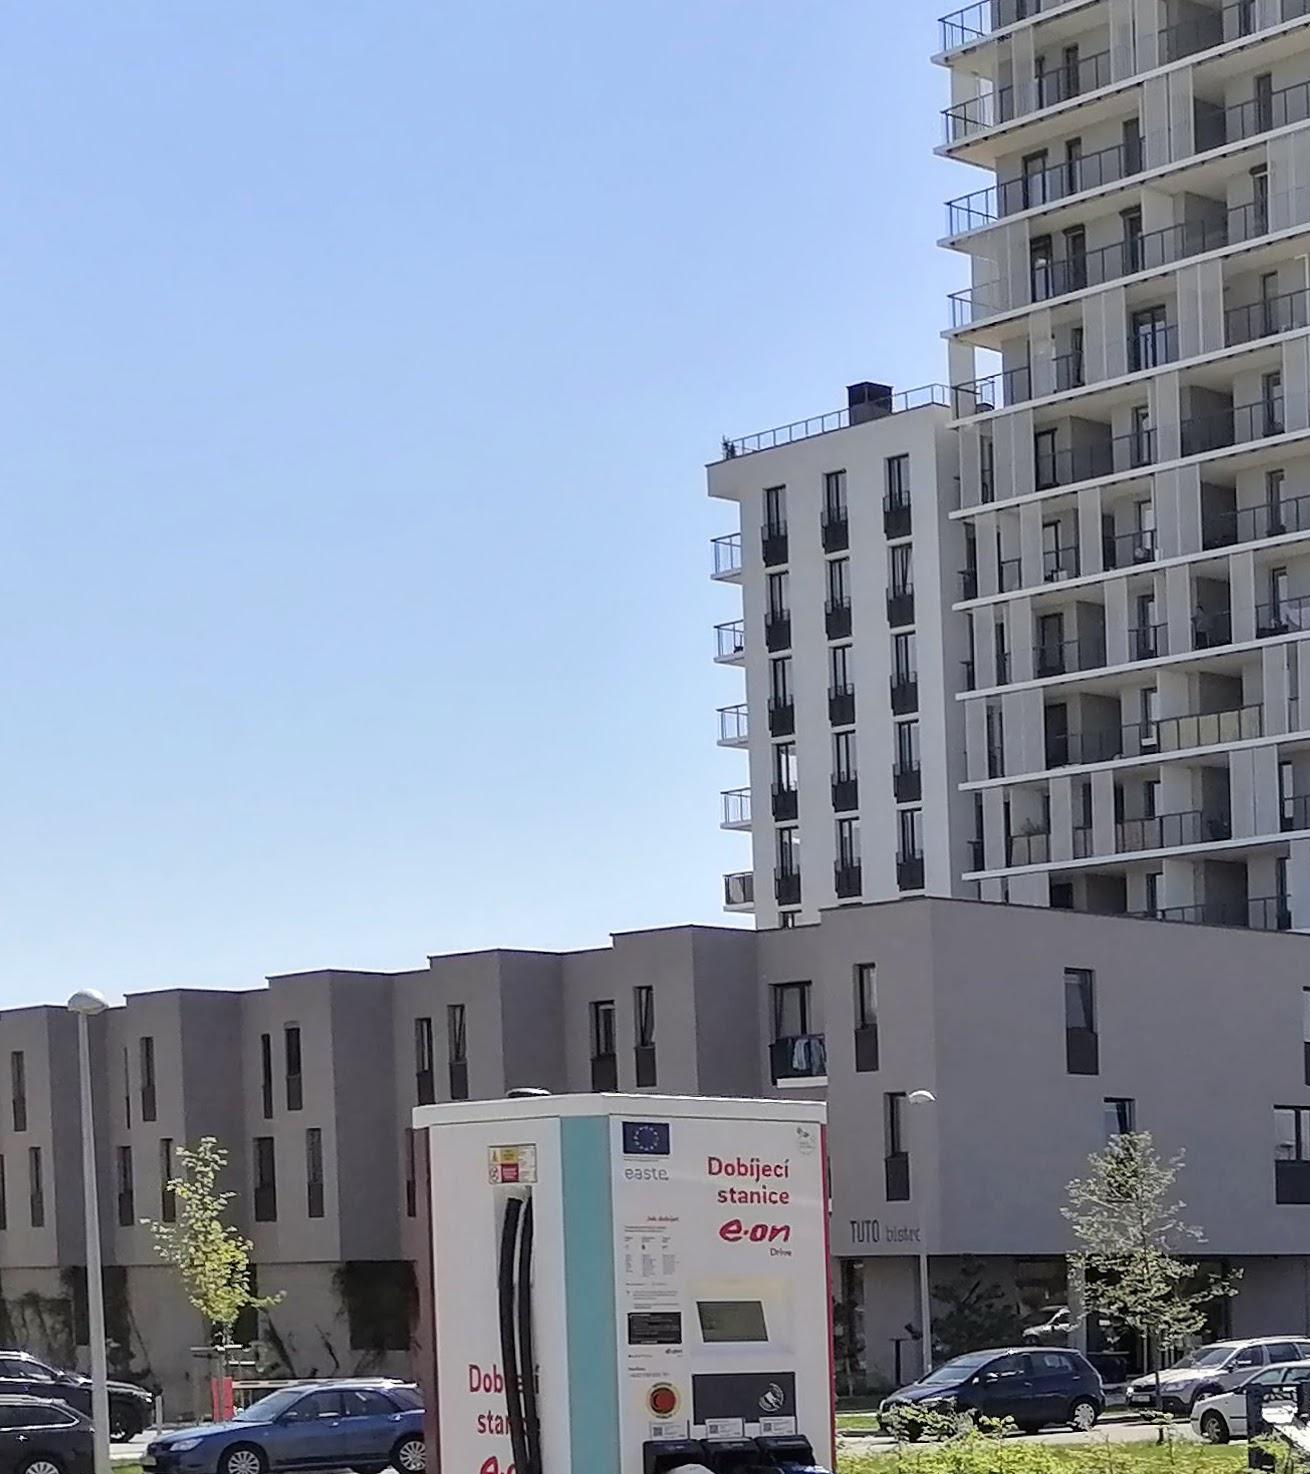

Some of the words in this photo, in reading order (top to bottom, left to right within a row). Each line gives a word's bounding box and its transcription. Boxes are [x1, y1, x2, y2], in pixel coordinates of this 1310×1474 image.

[707, 1156, 790, 1182] Dobíjecí
[716, 1185, 790, 1205] stanice
[850, 1219, 880, 1243] TUTO
[769, 1247, 792, 1257] Drive
